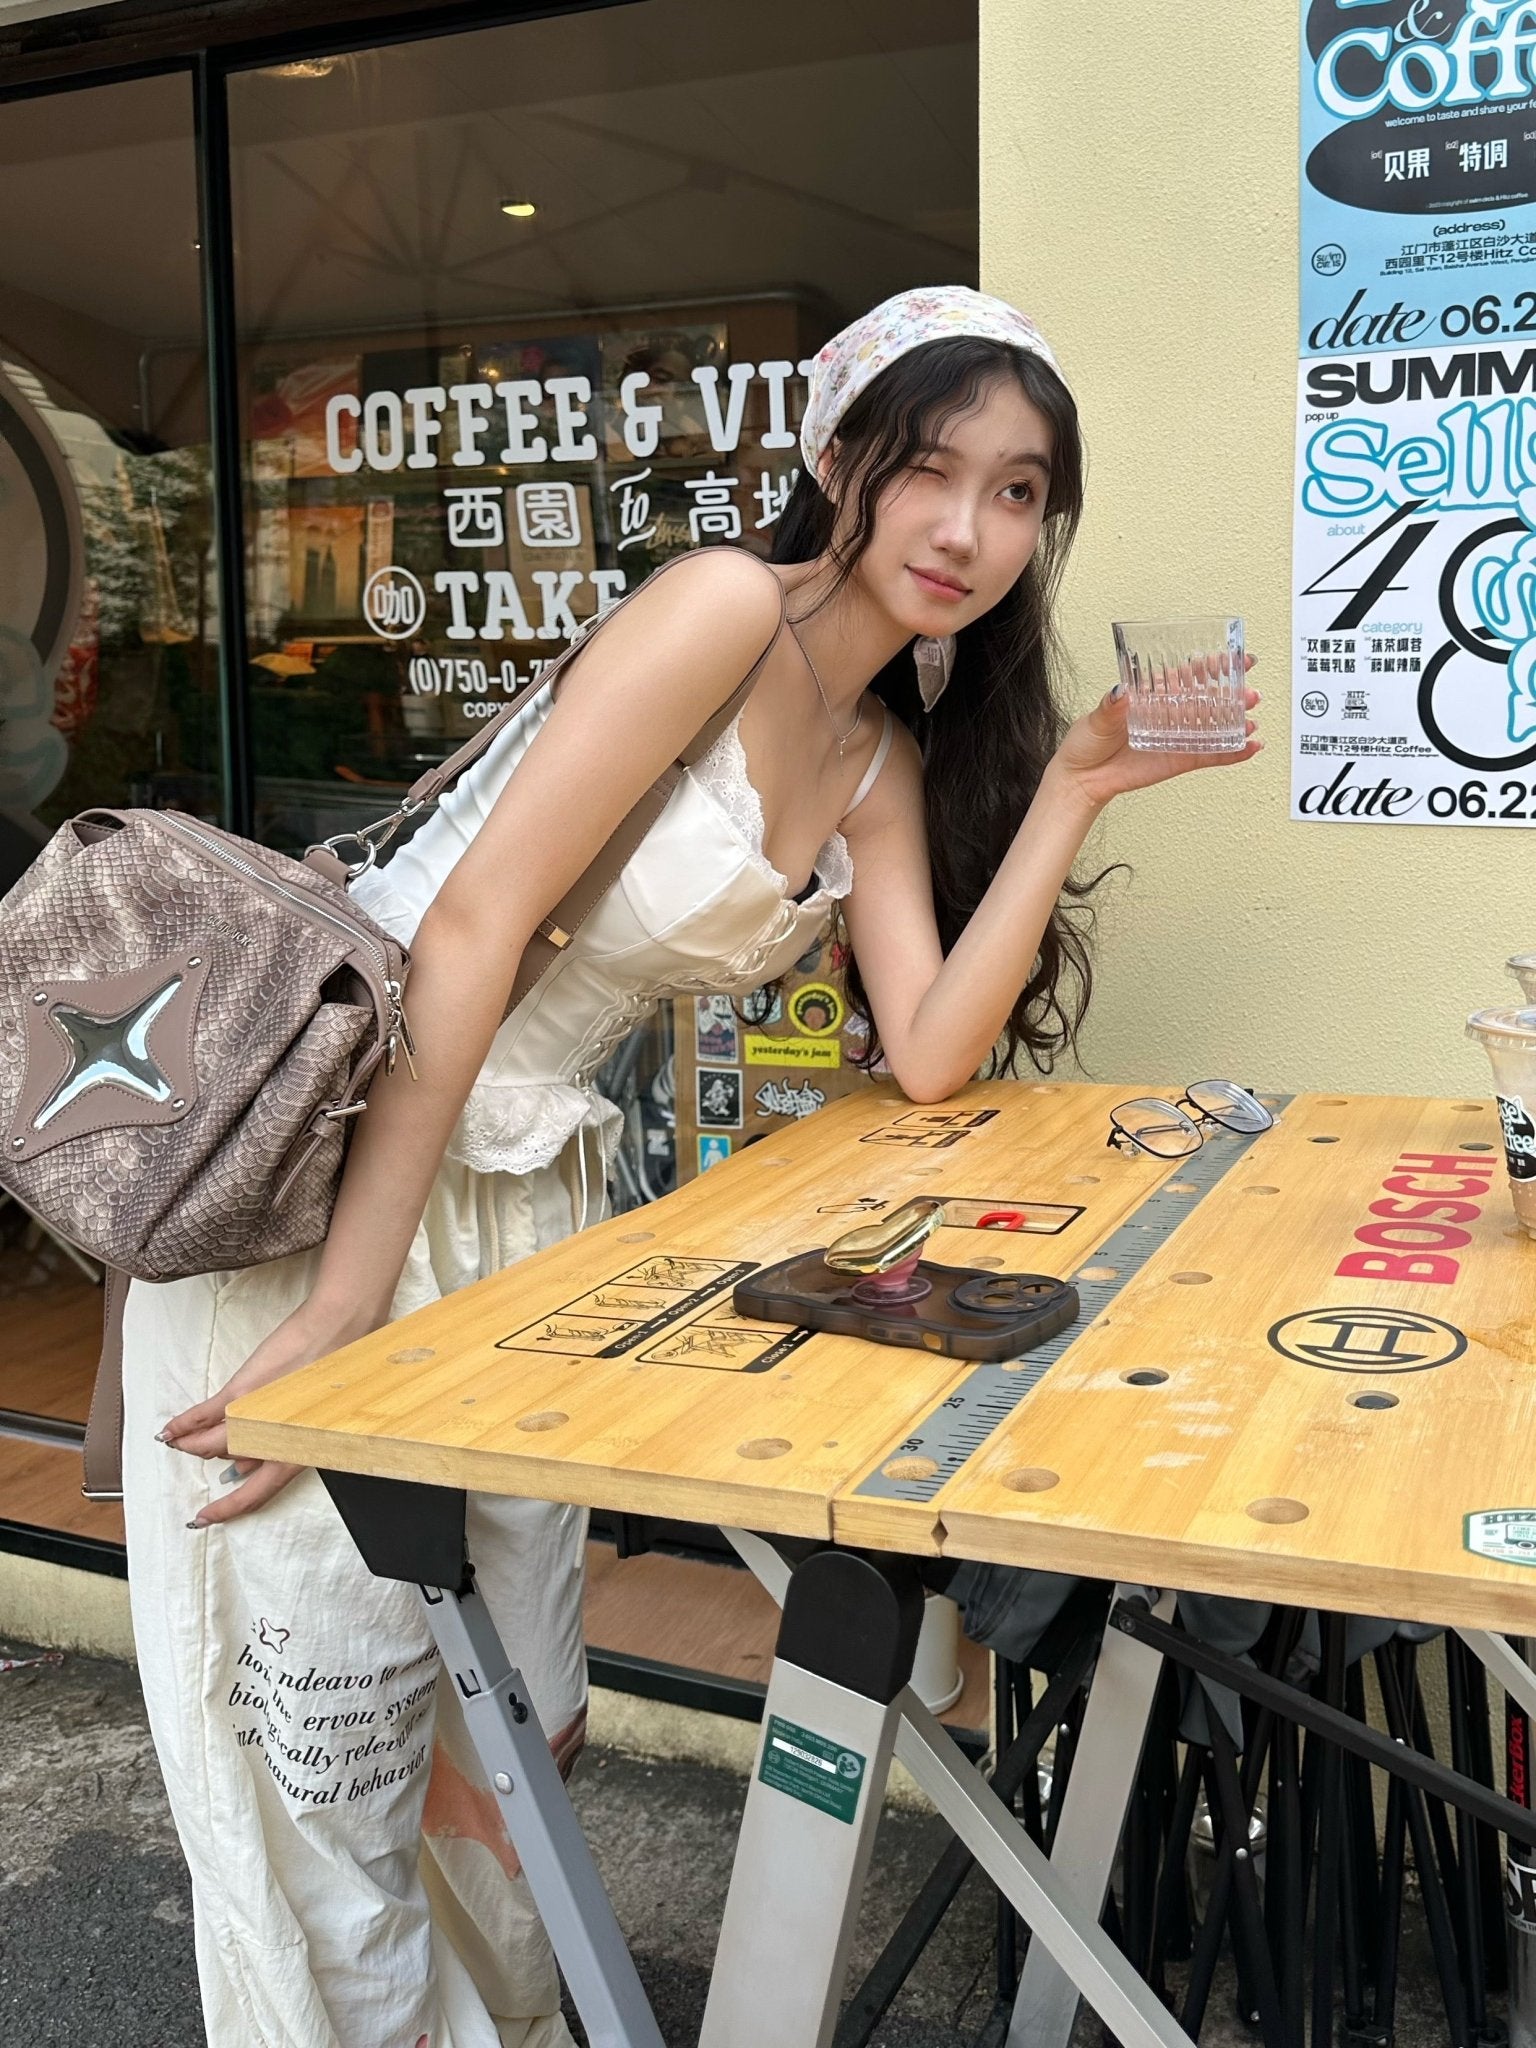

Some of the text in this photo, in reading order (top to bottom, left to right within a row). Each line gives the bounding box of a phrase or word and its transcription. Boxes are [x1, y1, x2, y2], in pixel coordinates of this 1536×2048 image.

[1314, 0, 1536, 121] Coff
[1385, 115, 1425, 127] welcome
[1427, 112, 1436, 122] to
[1437, 110, 1460, 120] taste
[1461, 106, 1478, 117] and
[1480, 105, 1505, 115] share
[1507, 102, 1528, 113] your
[1384, 147, 1430, 182] 贝果
[1459, 139, 1508, 173] 特调
[1433, 219, 1505, 237] (address)
[1307, 288, 1437, 350] date
[326, 376, 598, 474] COFFEE
[620, 372, 663, 458] &
[1304, 411, 1339, 424] pop up
[1302, 397, 1536, 518] Sell
[444, 481, 581, 548] 西園
[1326, 524, 1366, 537] about
[1361, 622, 1423, 634] category
[1299, 761, 1536, 819] date 06.2
[752, 1045, 832, 1058] yesterday's jam
[1334, 1153, 1498, 1284] BOSCH
[942, 1396, 966, 1409] 25
[900, 1437, 924, 1452] 30
[379, 1665, 397, 1685] to
